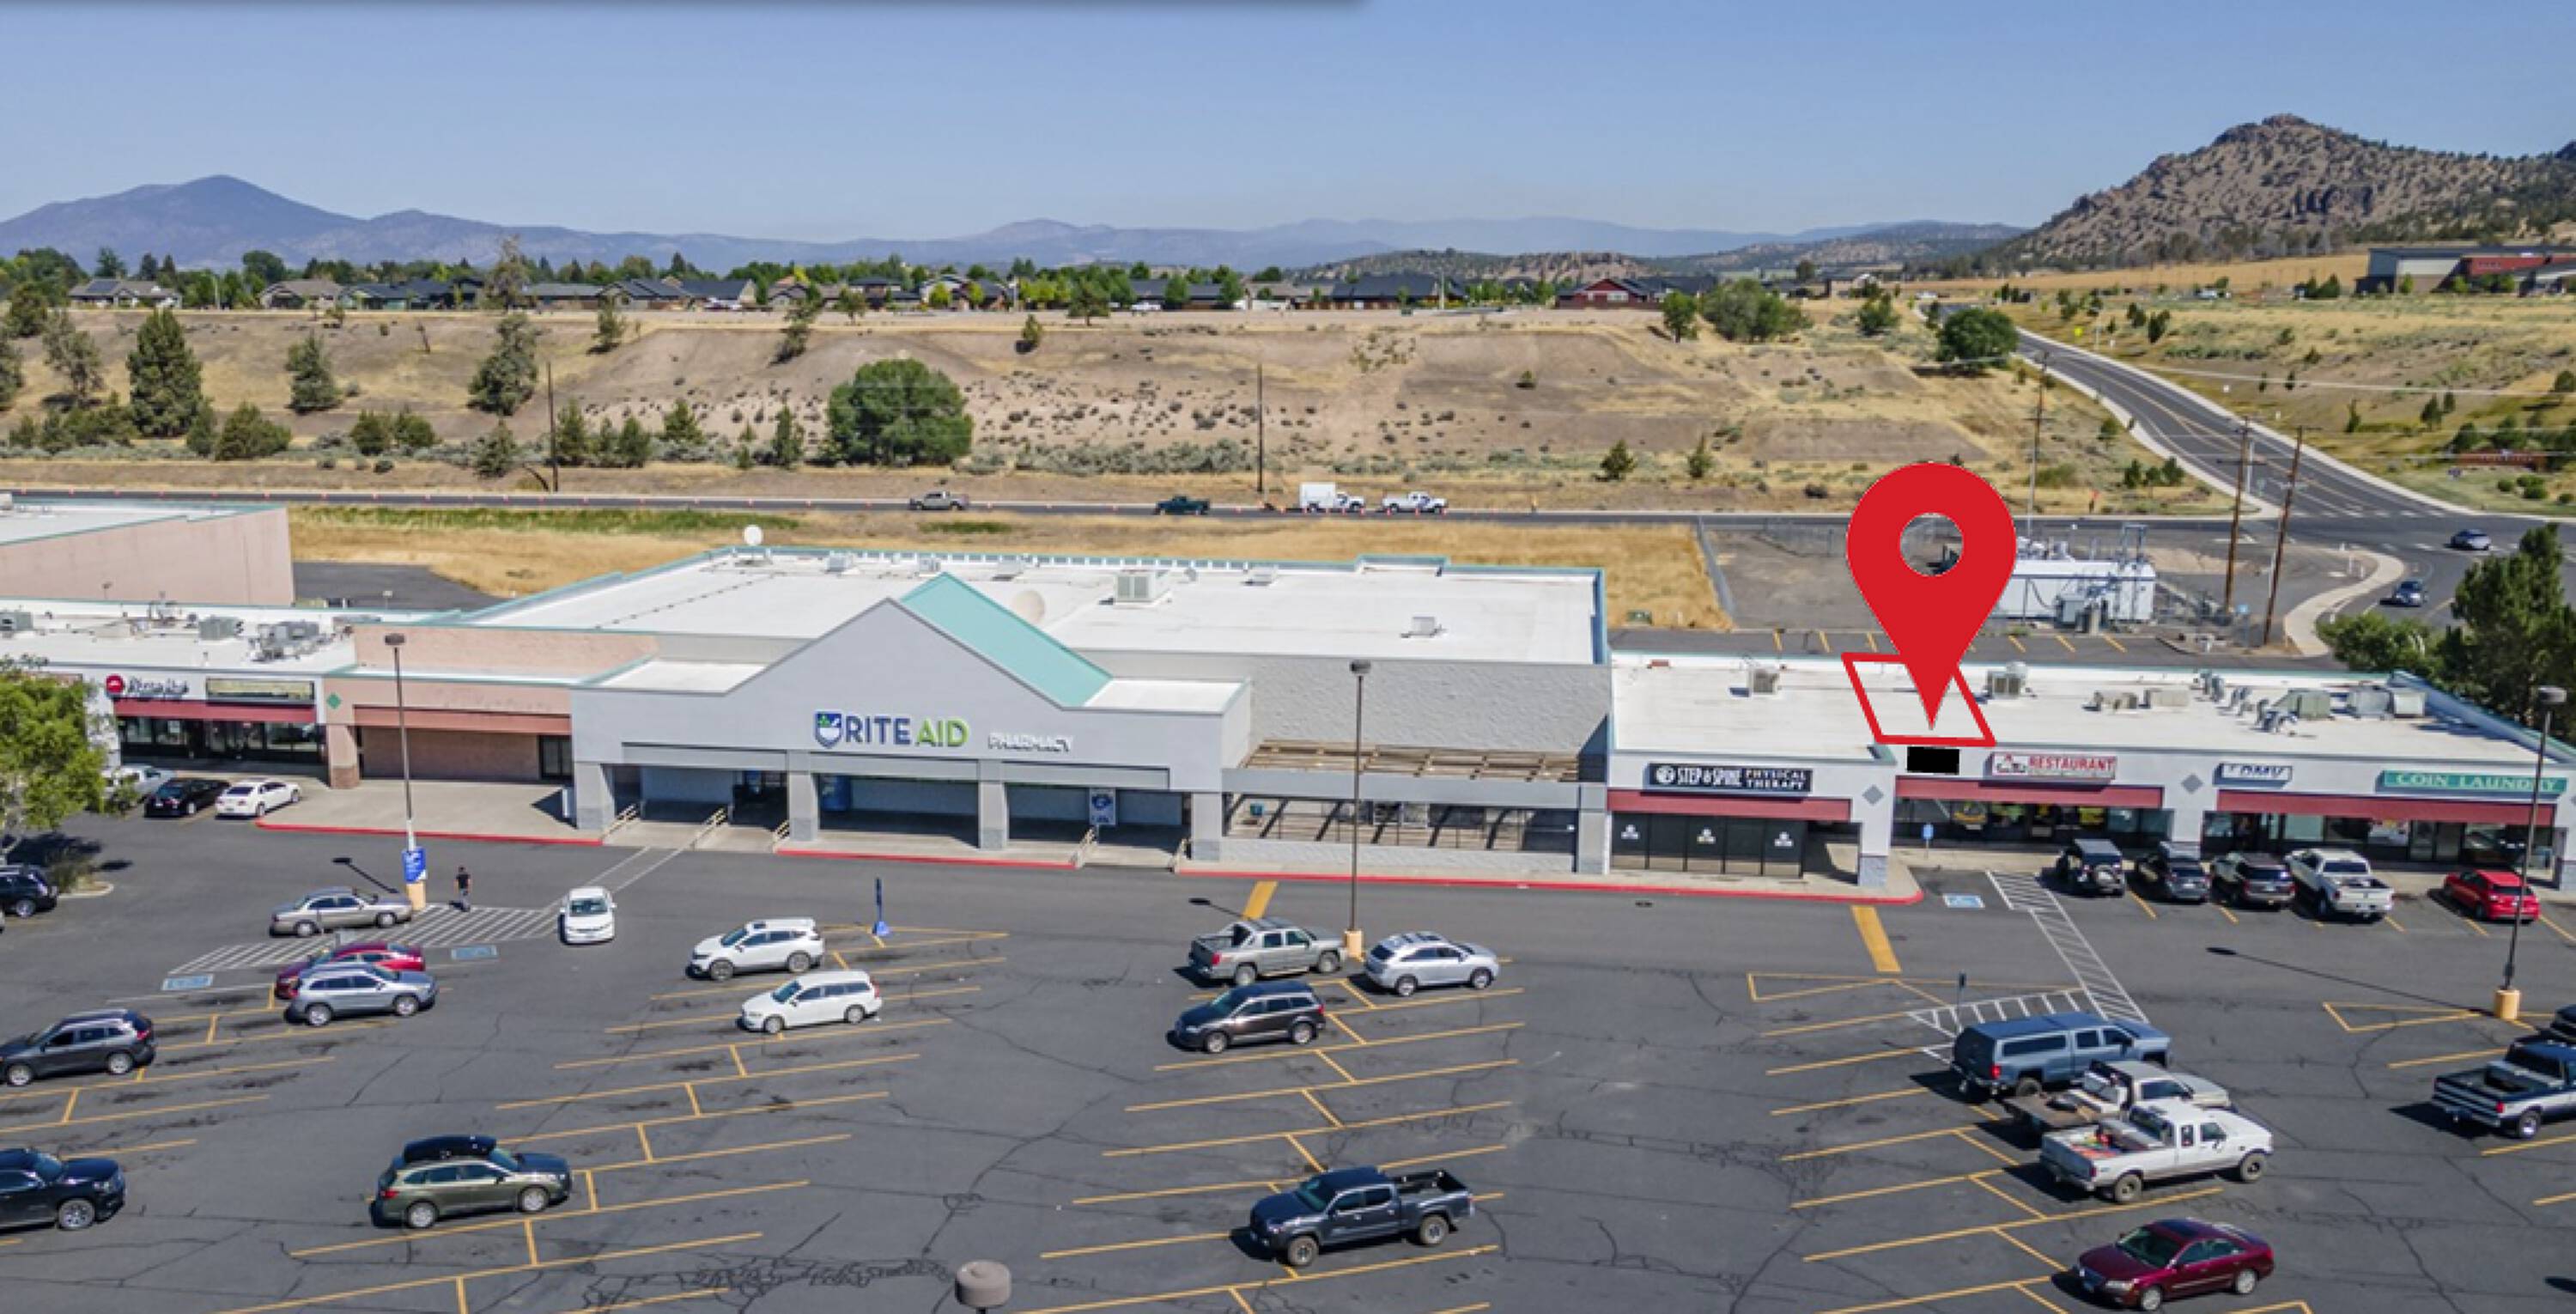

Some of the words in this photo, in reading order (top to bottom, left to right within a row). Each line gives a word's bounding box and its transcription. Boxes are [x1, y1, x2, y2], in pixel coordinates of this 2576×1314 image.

[845, 715, 911, 745] RITE
[914, 718, 969, 747] AID
[2029, 754, 2115, 771] RESTAURANT
[2395, 773, 2447, 787] COIN
